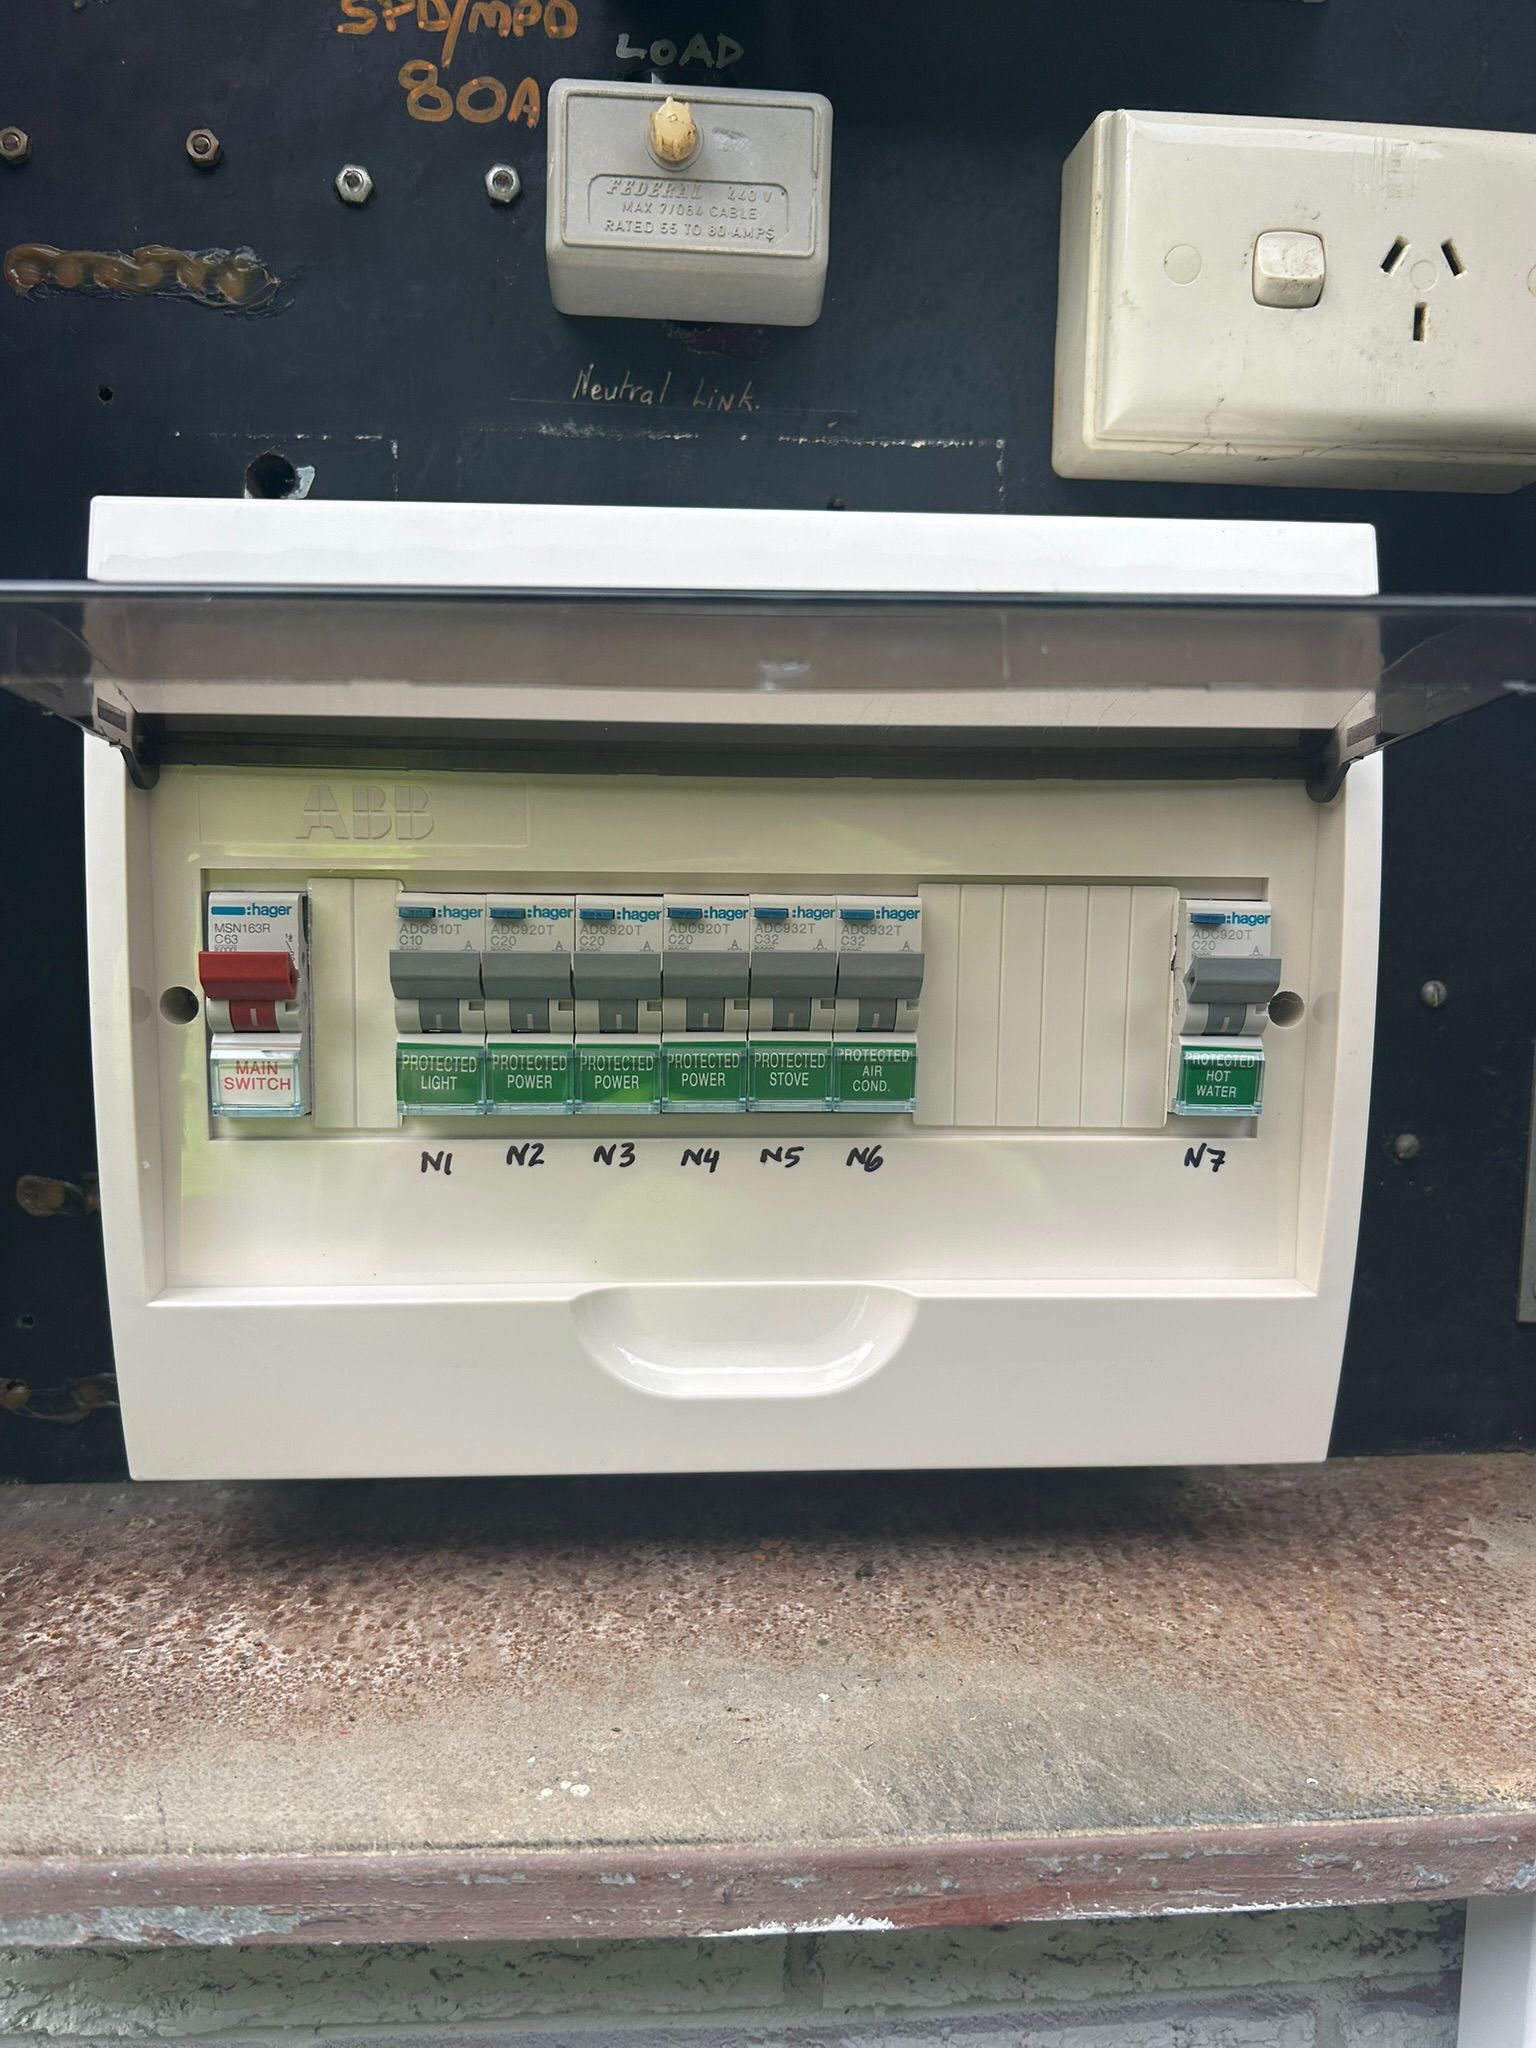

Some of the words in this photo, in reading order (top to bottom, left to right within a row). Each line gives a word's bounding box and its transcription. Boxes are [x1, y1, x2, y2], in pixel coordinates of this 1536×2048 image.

[616, 32, 744, 69] LOAD
[398, 59, 540, 128] 80A
[607, 180, 702, 199] FEDERAL
[622, 201, 652, 214] MAX
[709, 205, 758, 220] CABLE
[604, 219, 654, 234] RATED
[660, 222, 678, 235] 55
[684, 224, 701, 236] TO
[708, 225, 724, 238] 80
[732, 226, 775, 240] AMPS
[573, 363, 672, 405] Neutral
[296, 785, 435, 840] ABB
[214, 923, 271, 933] MSN163R
[400, 924, 462, 935] ADC910T
[491, 924, 555, 935] ADC920T
[579, 924, 643, 936] ADC920T
[668, 923, 730, 934] ADC920T
[754, 923, 816, 934] ADC932T
[841, 924, 902, 936] ADC932T
[1192, 929, 1252, 940] ADC920T
[214, 934, 238, 944] C63
[400, 935, 423, 946] C10
[491, 936, 516, 946] C20
[579, 936, 605, 946] C20
[668, 934, 694, 945] C20
[754, 934, 779, 945] C32
[841, 936, 865, 946] C32
[1191, 940, 1216, 951] C20
[492, 1055, 567, 1071] PROTECTED
[580, 1055, 654, 1071] PROTECTED
[667, 1053, 739, 1069] PROTECTED
[754, 1052, 825, 1068] PROTECTED
[839, 1049, 909, 1063] PROTECTED
[1184, 1052, 1255, 1068] PROTECTED
[236, 1060, 278, 1074] MAIN
[402, 1055, 477, 1072] PROTECTED
[862, 1066, 882, 1077] AIR
[1207, 1070, 1231, 1082] HOT
[224, 1077, 291, 1090] SWITCH
[420, 1075, 457, 1090] LIGHT
[507, 1075, 552, 1089] POWER
[594, 1075, 639, 1089] POWER
[681, 1072, 726, 1087] POWER
[769, 1072, 809, 1086] STOVE
[853, 1080, 890, 1092] COND.
[1196, 1085, 1237, 1098] WATER
[506, 1142, 545, 1167] N2
[593, 1142, 636, 1168] N3
[680, 1148, 720, 1173] N4
[760, 1145, 804, 1168] N5
[846, 1145, 884, 1172] N6
[1184, 1143, 1226, 1172] N7
[421, 1150, 453, 1175] N1
